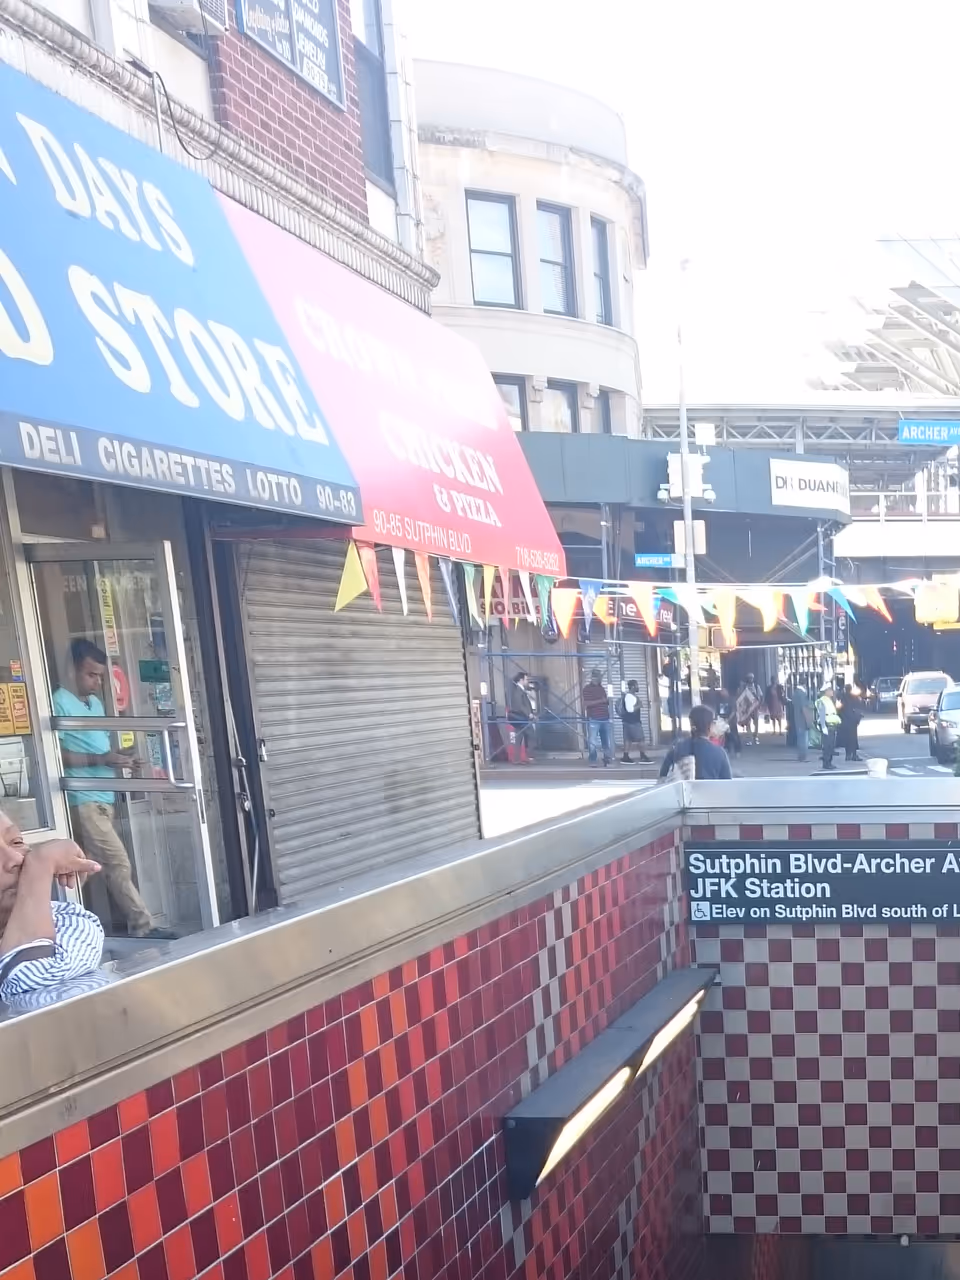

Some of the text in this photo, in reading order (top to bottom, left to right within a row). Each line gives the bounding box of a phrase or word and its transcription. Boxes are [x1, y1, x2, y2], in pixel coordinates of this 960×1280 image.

[16, 111, 195, 268] DAYS
[67, 264, 330, 446] STORE
[379, 409, 504, 496] CHICKEN
[902, 424, 949, 441] ARCHER
[19, 421, 356, 517] DELI CIGARETTES LOTTO 90-83
[450, 489, 502, 528] PIZZA
[373, 509, 472, 554] 90-85 SUTPHIN BLVD
[688, 853, 781, 880] Sutphin
[788, 853, 936, 874] Blvd-Archer
[689, 878, 831, 899] JFK Station
[711, 904, 746, 919] Elev
[750, 907, 770, 919] on
[774, 904, 837, 922] Sutphin
[841, 904, 877, 919] Blvd
[881, 904, 927, 919] south
[931, 904, 949, 919] of
